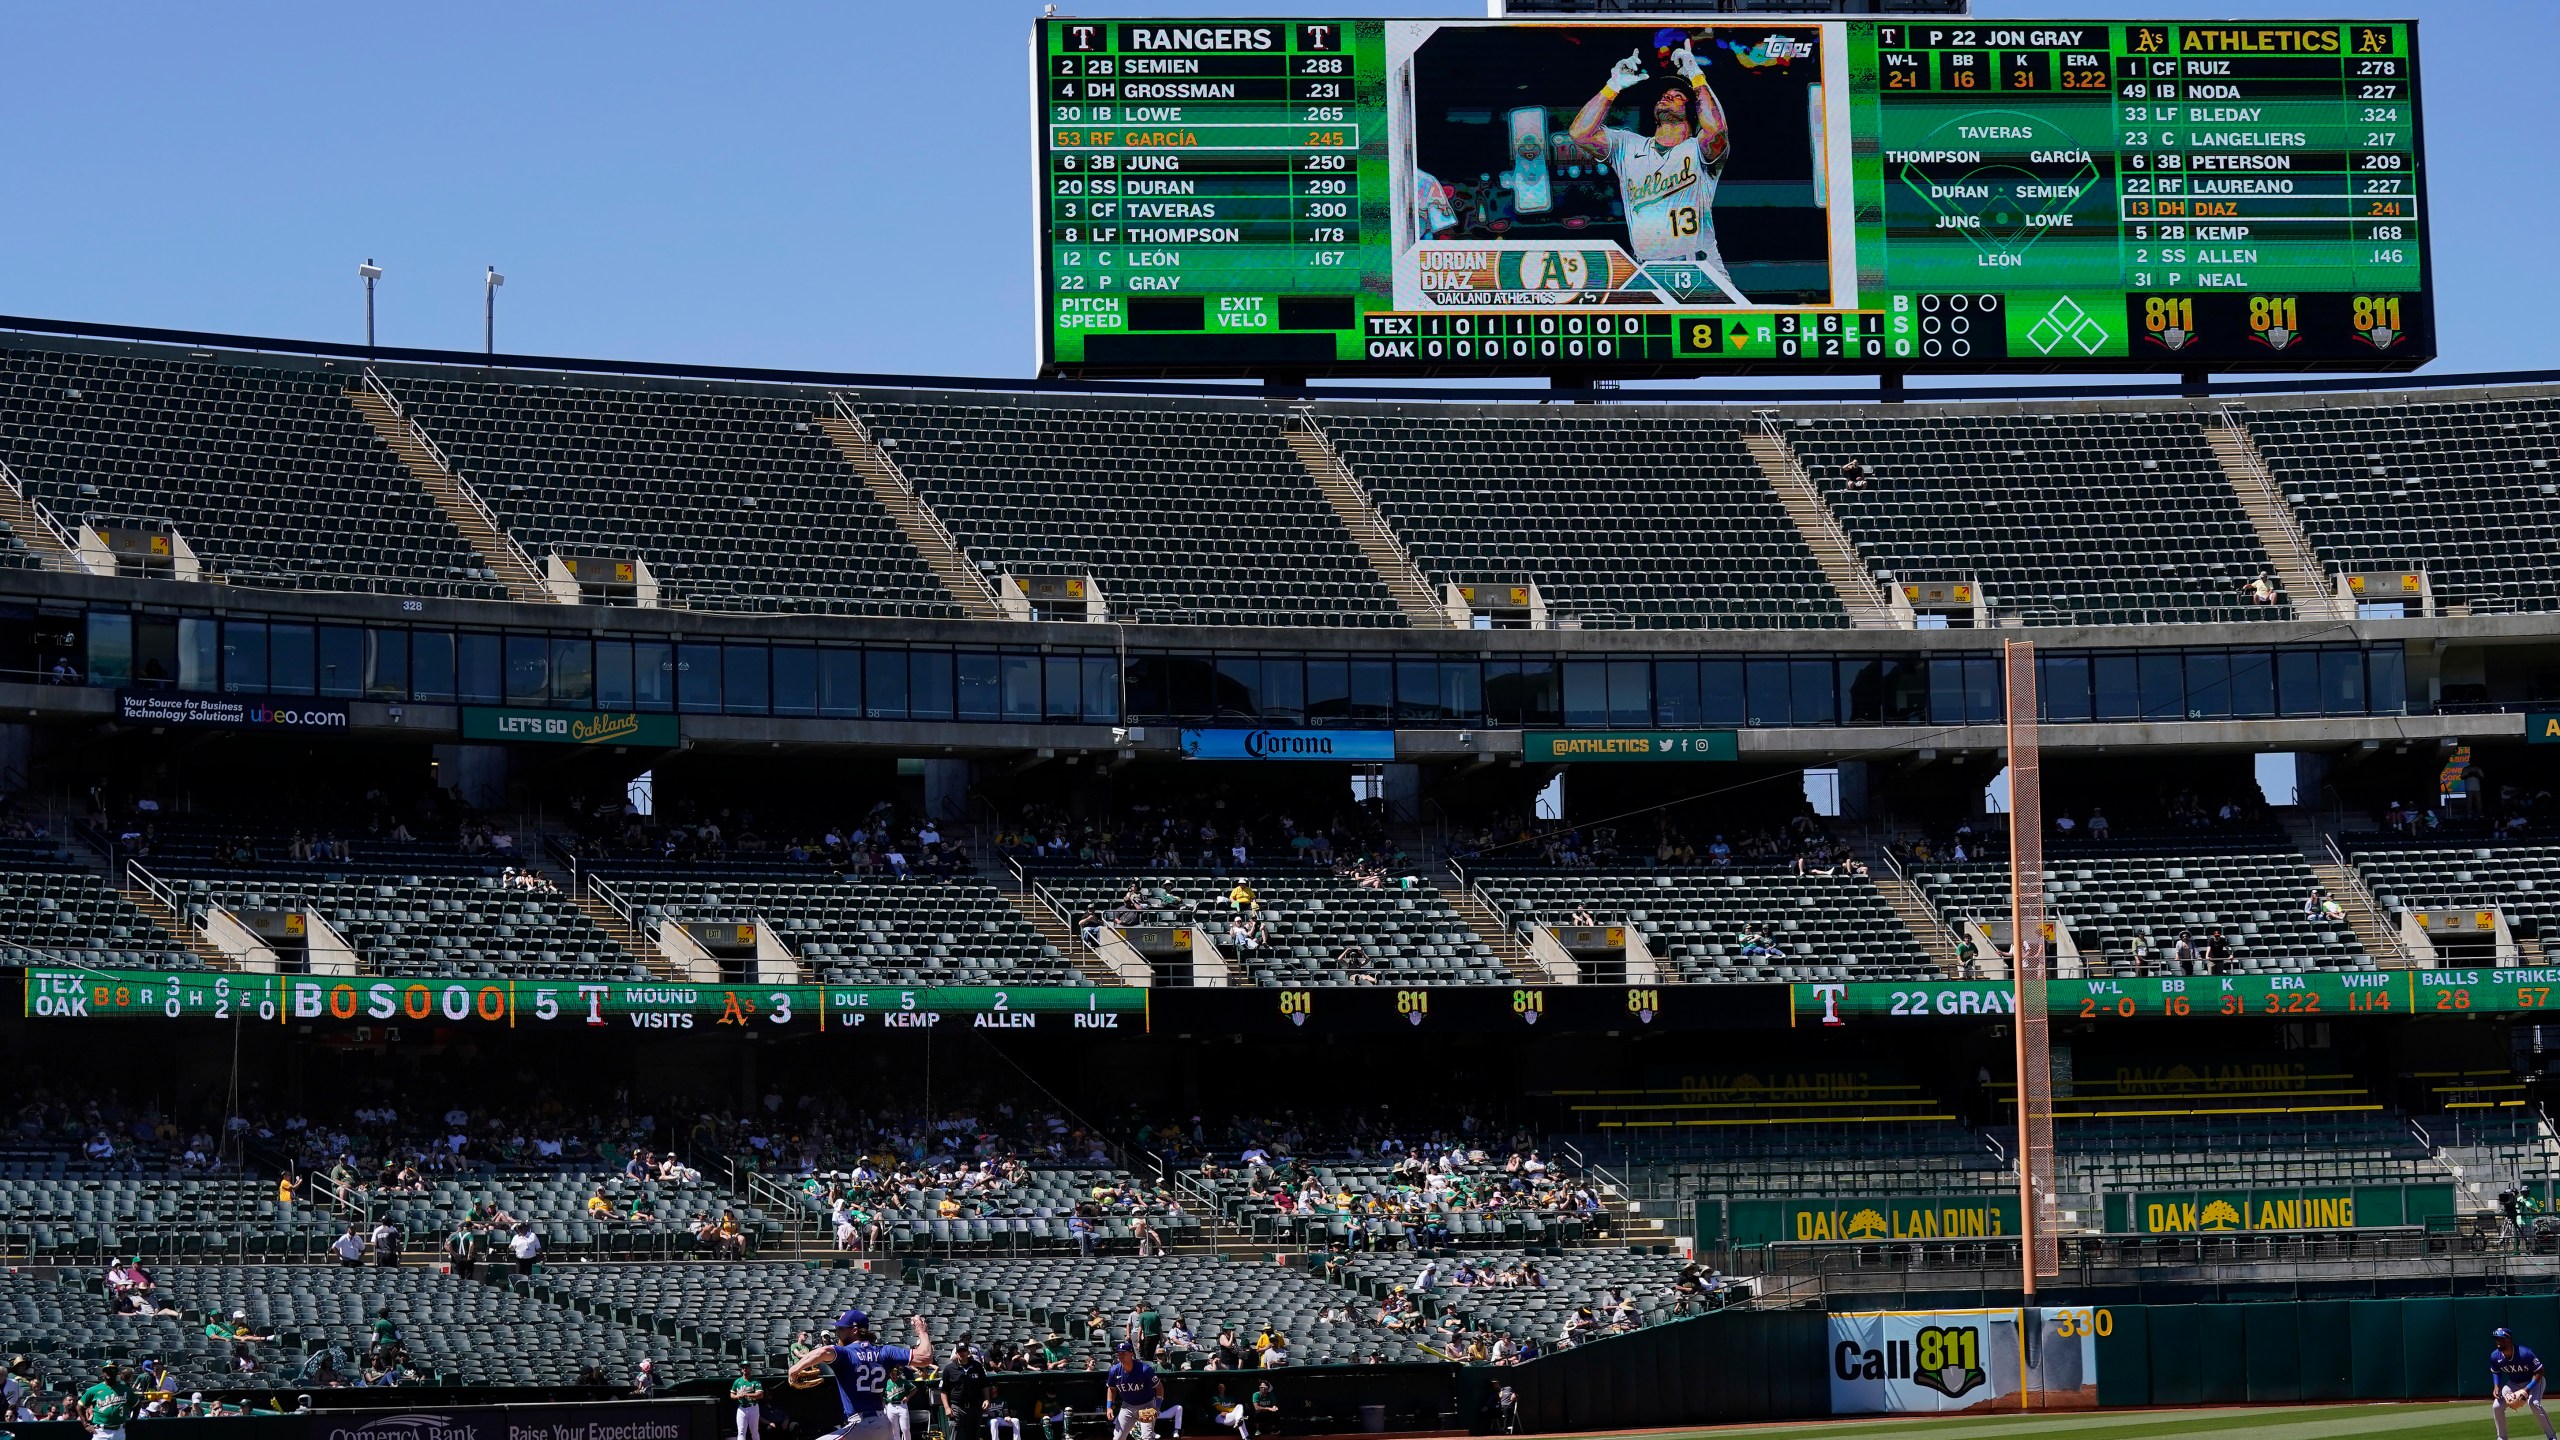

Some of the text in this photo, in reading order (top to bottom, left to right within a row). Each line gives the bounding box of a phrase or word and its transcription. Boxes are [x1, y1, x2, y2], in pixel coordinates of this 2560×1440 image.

[1133, 29, 1271, 50] RANGERS
[1952, 31, 2083, 46] 22 JON GRAY
[2183, 31, 2339, 51] ATHLETICS
[1088, 59, 1342, 74] 2B SEMIEN .288
[1886, 55, 2098, 66] W-L BB K ERA
[2152, 61, 2395, 76] CF RUIZ .278
[1889, 71, 2106, 87] 2-1 16 31 3.22
[1088, 84, 1340, 98] DH GROSSMAN .231
[2157, 85, 2396, 99] 1B NODA .227
[1093, 108, 1344, 121] 1B LOWE .265
[2156, 108, 2397, 121] LF BLEDAY .324
[1090, 129, 1344, 146] RF GARCÍA .245
[1958, 126, 2032, 139] TAVERAS
[2191, 133, 2396, 146] LANGELIERS .217
[1091, 156, 1345, 170] 3B JUNG .250
[1886, 150, 1980, 163] THOMPSON
[2030, 148, 2092, 163] GARCÍA
[2157, 155, 2401, 170] 3B PETERSON .209
[1090, 180, 1346, 195] SS DURAN .290
[1932, 186, 1988, 198] DURAN
[2016, 186, 2079, 198] SEMIEN
[2158, 179, 2401, 193] RF LAUREANO .227
[1091, 203, 1347, 218] CF TAVERAS .300
[2158, 202, 2400, 216] DH DIAZ .241
[1670, 206, 1699, 237] 13
[1935, 216, 1980, 228] JUNG
[2025, 215, 2073, 227] LOWE
[1093, 228, 1344, 243] LF THOMPSON .178
[2161, 226, 2402, 240] 2B KEMP .168
[1129, 249, 1344, 267] LEÓN .167
[1420, 252, 1487, 271] JORDAN
[1978, 252, 2021, 266] LEÓN
[2161, 249, 2403, 263] SS ALLEN .146
[1129, 276, 1181, 291] GRAY
[1422, 272, 1473, 290] DIAZ
[1674, 272, 1691, 288] 13
[2198, 273, 2247, 287] NEAL
[1062, 298, 1118, 312] PITCH
[1221, 297, 1263, 311] EXIT
[1437, 292, 1555, 305] OAKLAND ATHLETICS
[1060, 314, 1122, 329] SPEED
[1217, 313, 1267, 327] VELO
[2145, 297, 2193, 331] 811
[2250, 297, 2297, 331] 811
[2353, 297, 2400, 331] 811
[1370, 318, 1412, 334] TEX
[1692, 324, 1712, 348] 8
[1370, 342, 1414, 358] OAK
[403, 601, 422, 610] 328
[124, 697, 243, 712] Your Source for Business
[124, 707, 243, 722] Technology Solutions!
[250, 704, 345, 726] ubeo.com
[2190, 710, 2200, 718] 64
[499, 714, 638, 743] LET'S GO Oakland
[1244, 729, 1333, 760] Corona
[1553, 739, 1649, 755] @ATHLETICS
[35, 973, 85, 995] TEX
[2271, 974, 2390, 990] ERA WHIP
[2422, 973, 2479, 986] BALLS
[626, 988, 697, 1005] MOUND
[835, 994, 869, 1006] DUE
[1280, 991, 1311, 1014] 811
[1891, 991, 2017, 1015] 22 GRAY
[2265, 991, 2390, 1013] 3.22 1.14
[2437, 987, 2550, 1009] 28 57
[36, 997, 88, 1017] OAK
[630, 1012, 693, 1029] VISITS
[842, 1014, 865, 1027] UP
[884, 1013, 940, 1028] KEMP
[974, 1013, 1035, 1028] ALLEN
[1074, 1013, 1118, 1028] RUIZ
[2148, 1198, 2352, 1232] OAK LANDING
[1797, 1208, 2001, 1240] OAK LANDING
[2057, 1308, 2113, 1338] 330
[857, 1352, 879, 1362] GRAY
[1835, 1330, 1976, 1381] Call 811
[2500, 1365, 2529, 1373] TEXAS
[856, 1364, 886, 1393] 22
[509, 1421, 679, 1440] Raise Your Expectations
